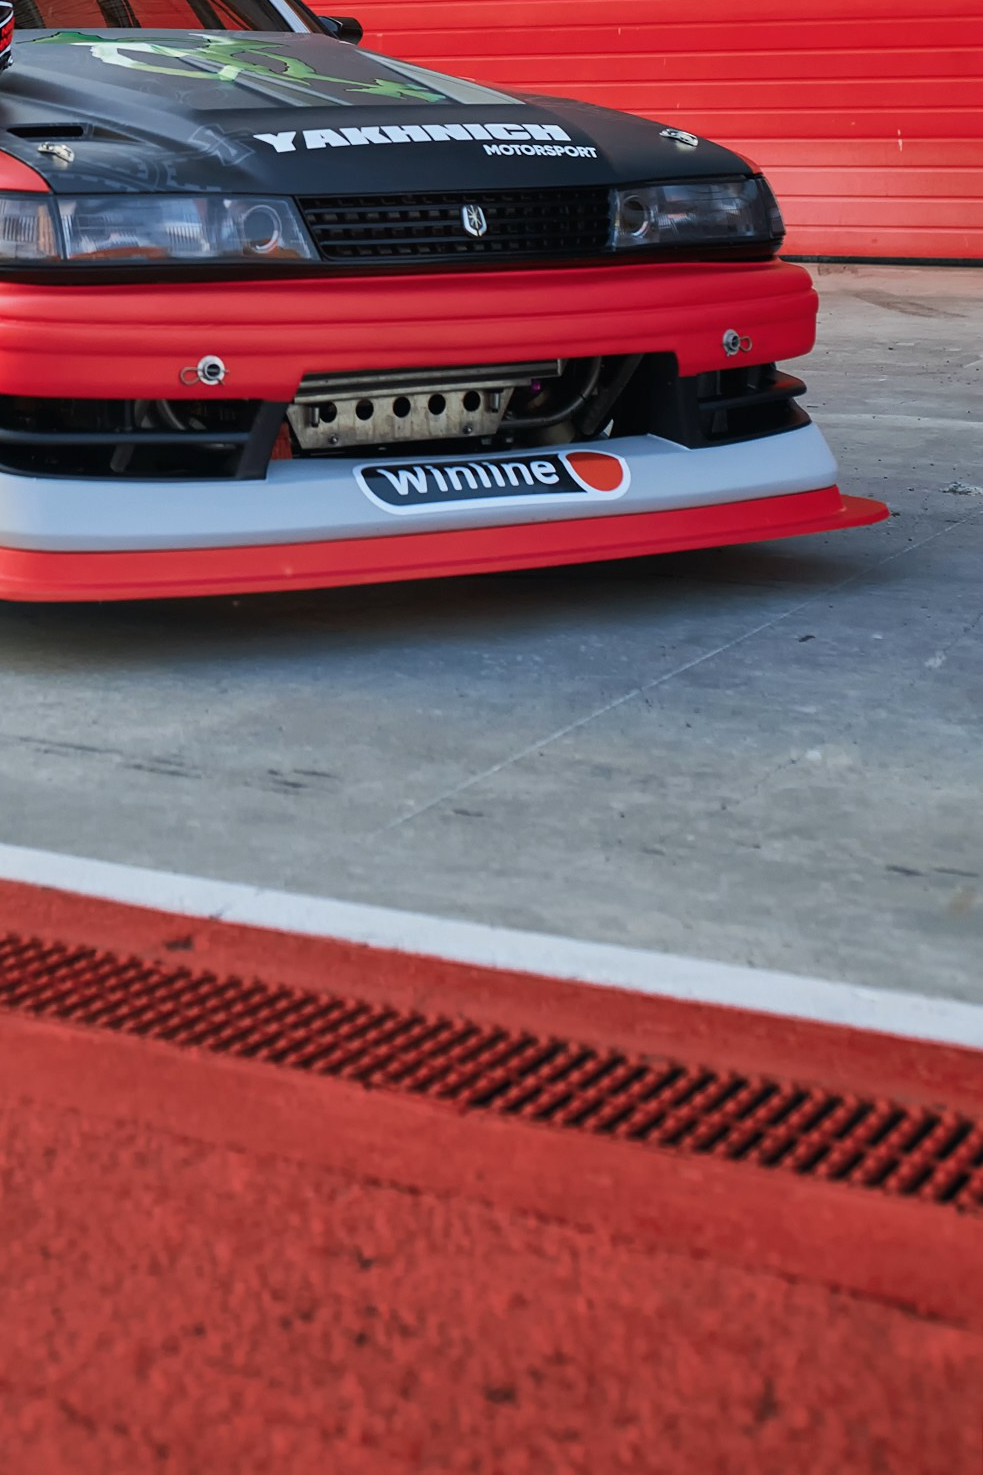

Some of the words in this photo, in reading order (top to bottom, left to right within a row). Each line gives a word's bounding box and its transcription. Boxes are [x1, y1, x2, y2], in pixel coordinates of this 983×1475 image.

[253, 123, 572, 154] YAKHNICH
[483, 143, 598, 159] MOTORSPORT
[376, 459, 560, 496] winline
